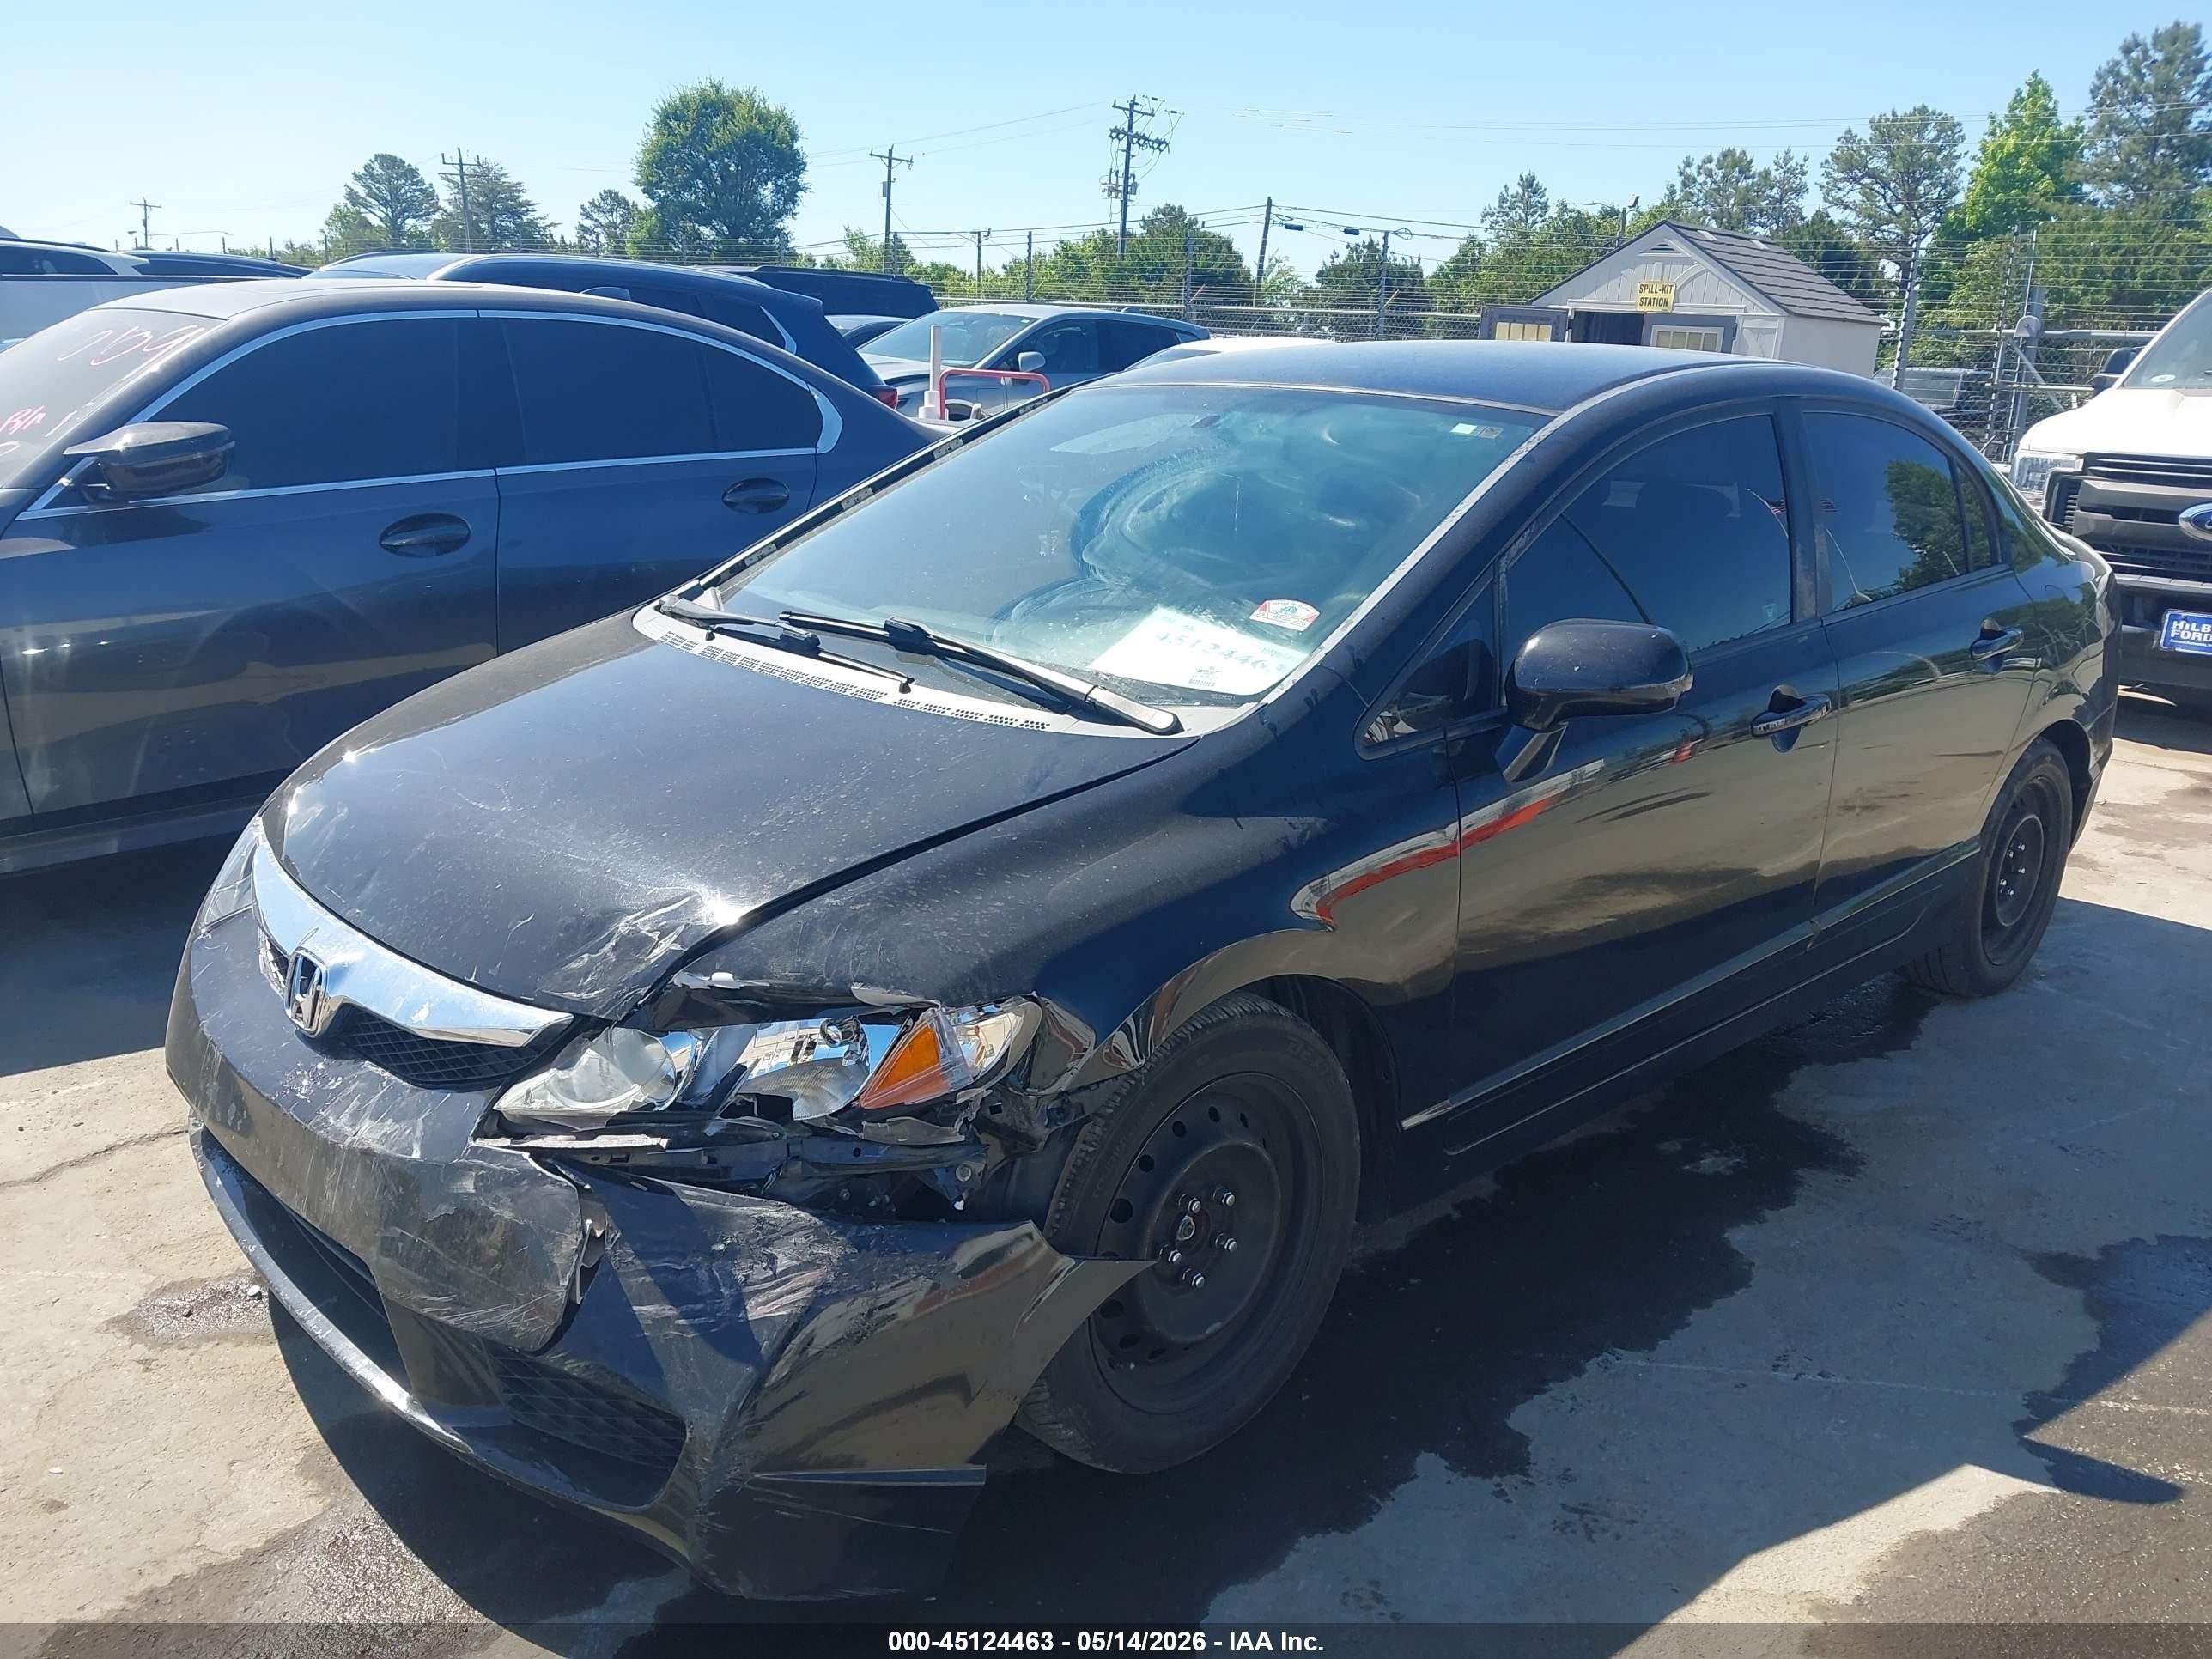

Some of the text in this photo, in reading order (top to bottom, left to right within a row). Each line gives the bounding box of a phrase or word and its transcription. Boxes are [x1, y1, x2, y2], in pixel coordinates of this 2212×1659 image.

[1638, 283, 1674, 294] SPILL-KIT
[1638, 296, 1669, 307] STATION
[2170, 629, 2212, 642] FORD
